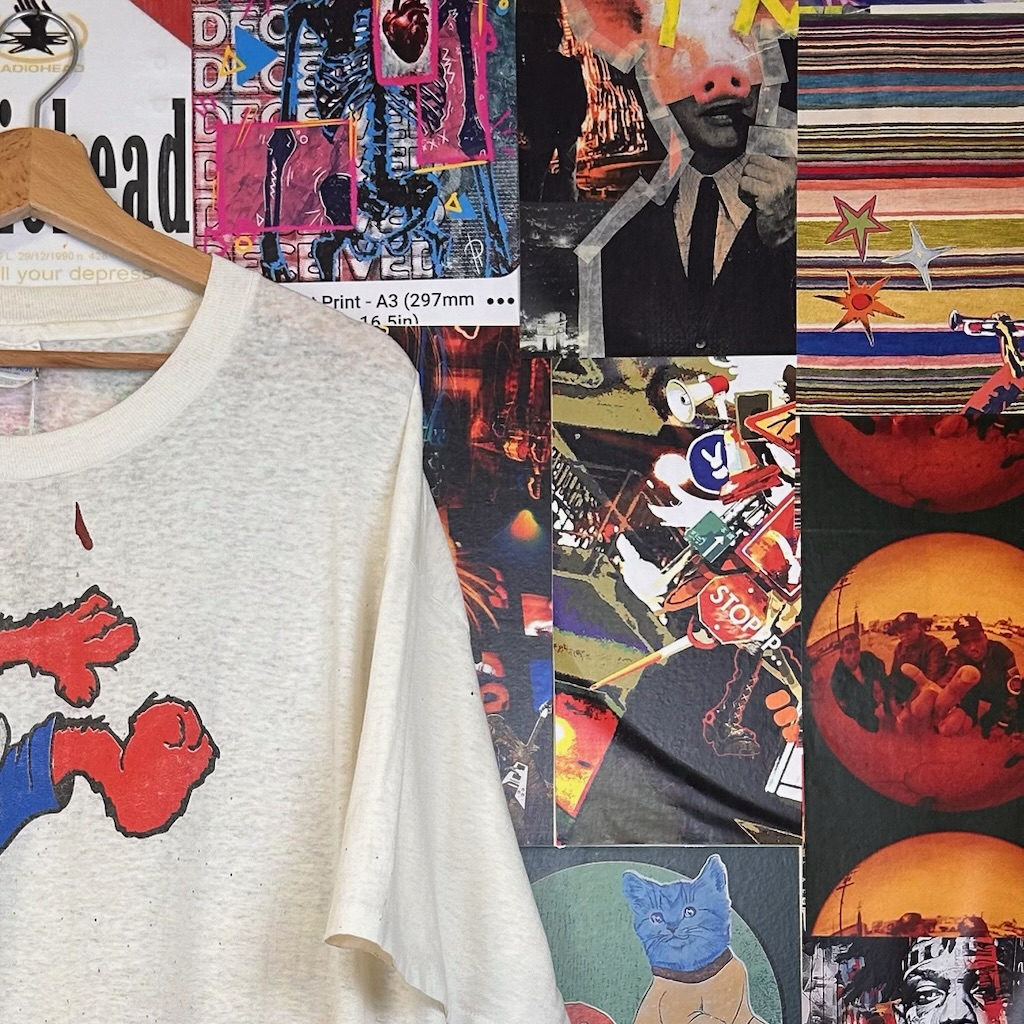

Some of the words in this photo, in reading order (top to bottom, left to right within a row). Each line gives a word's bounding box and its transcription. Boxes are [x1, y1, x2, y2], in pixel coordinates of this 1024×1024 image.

[18, 270, 60, 284] your
[323, 293, 362, 309] Print
[376, 294, 398, 307] A3
[404, 292, 474, 309] (297mm
[709, 585, 762, 632] STOP
